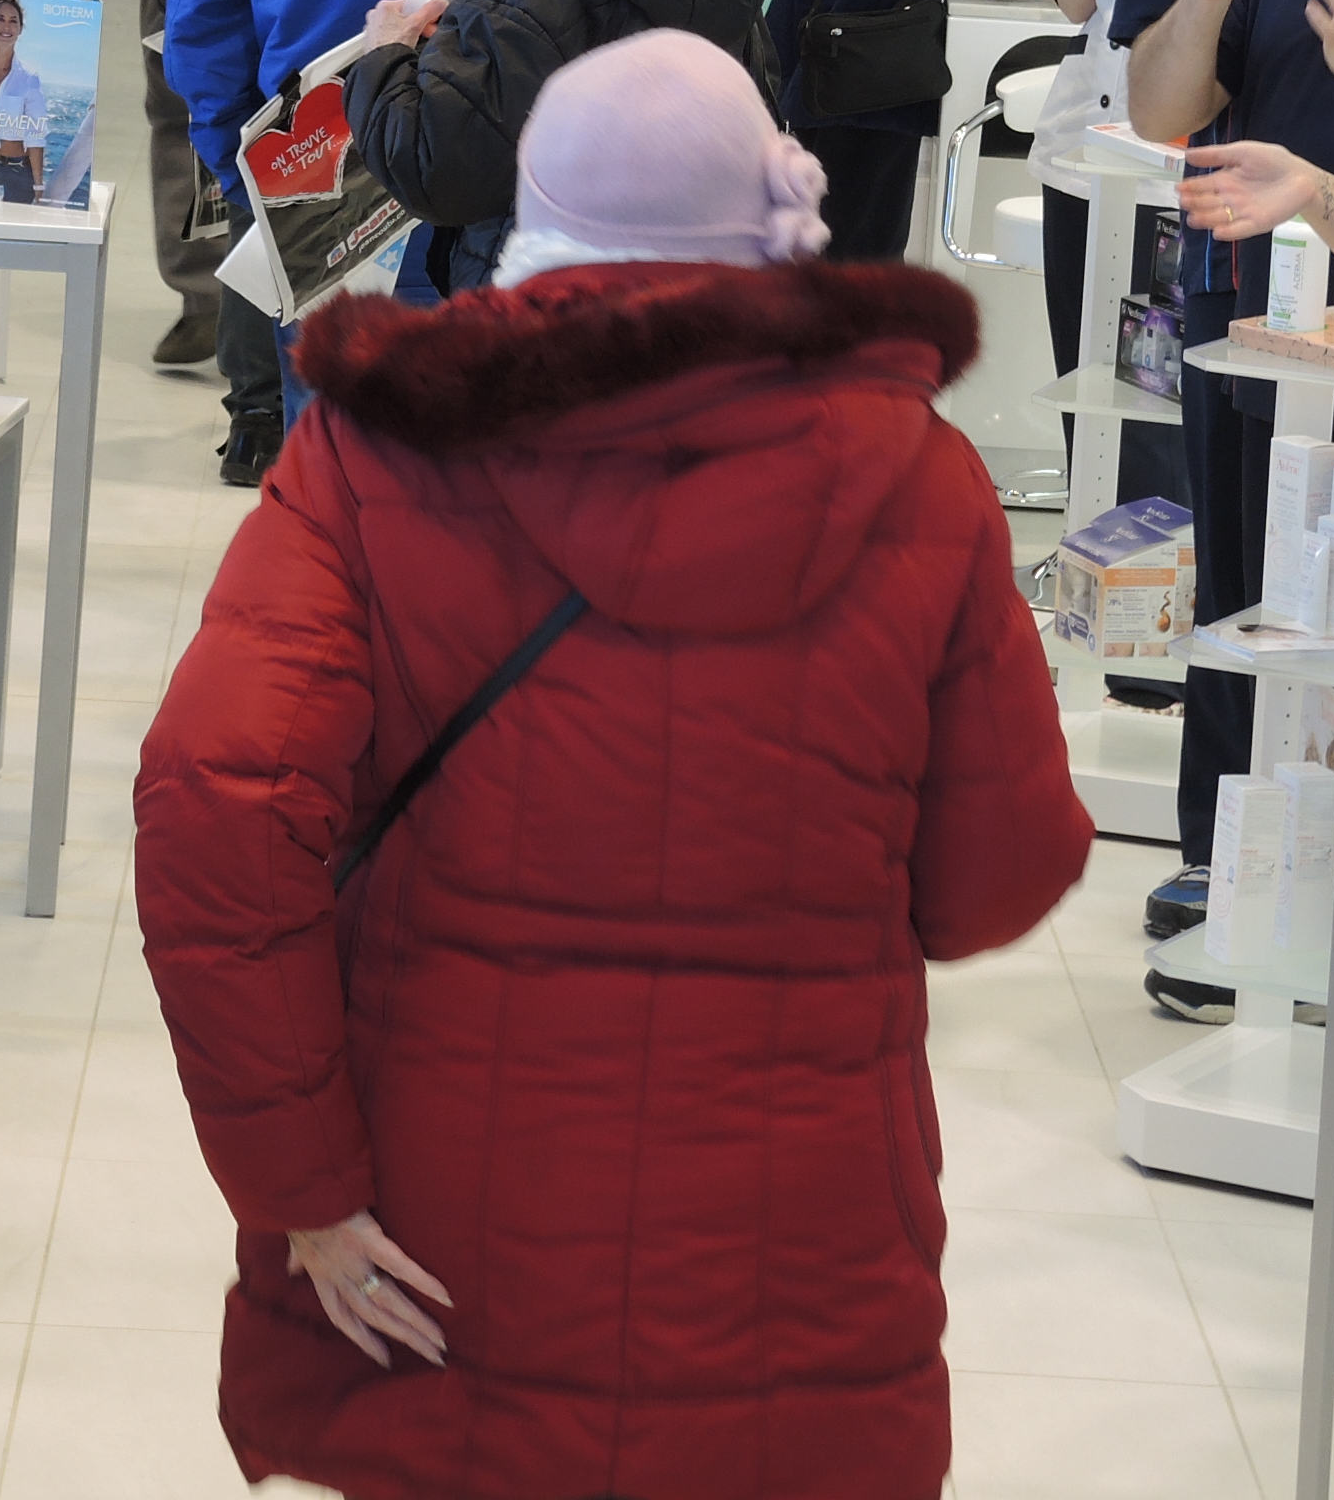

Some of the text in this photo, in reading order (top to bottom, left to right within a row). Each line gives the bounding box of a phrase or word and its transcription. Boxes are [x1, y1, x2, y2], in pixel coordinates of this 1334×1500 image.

[43, 4, 94, 19] BIOTHERM
[271, 126, 328, 171] ON TROUVE
[282, 167, 296, 177] DE
[351, 208, 388, 246] Jean
[358, 209, 405, 253] jeancoutu.co
[1293, 252, 1302, 290] A-DERMA
